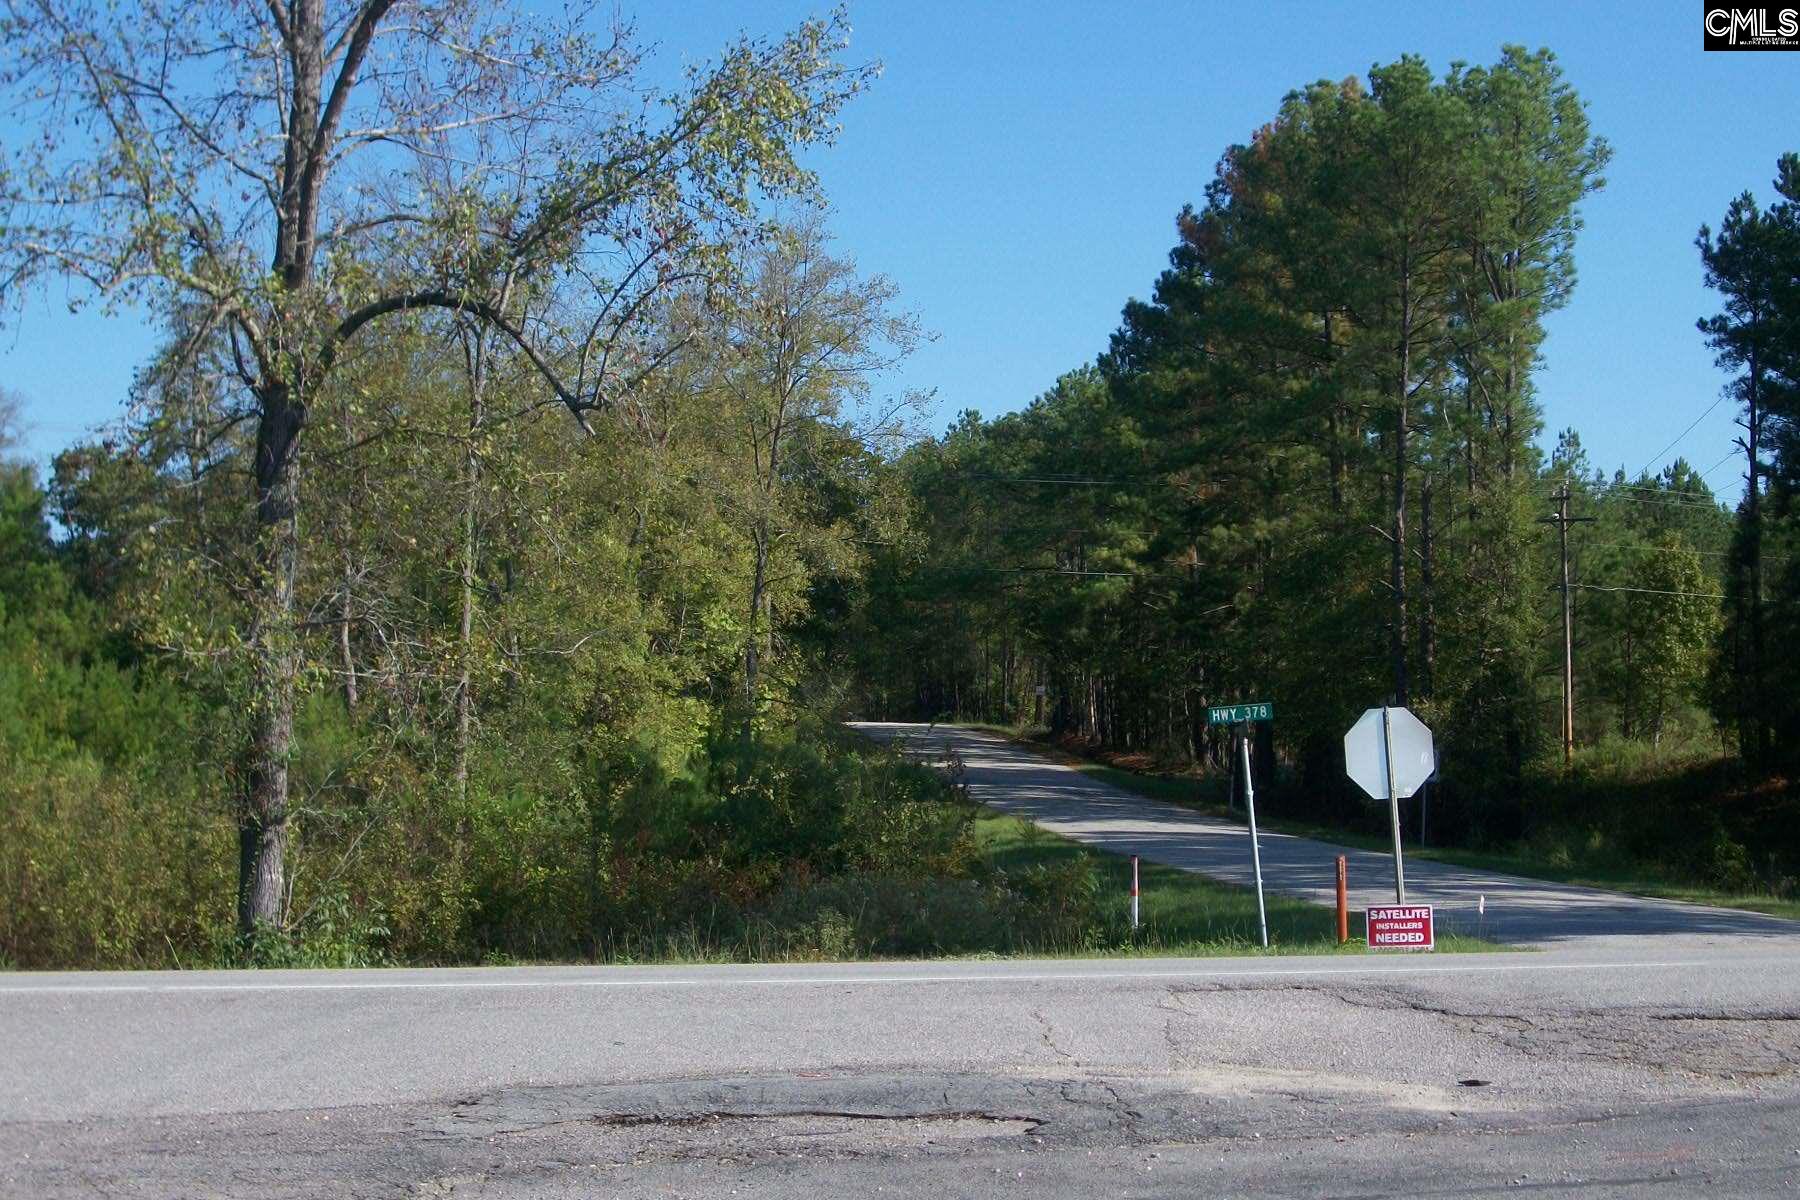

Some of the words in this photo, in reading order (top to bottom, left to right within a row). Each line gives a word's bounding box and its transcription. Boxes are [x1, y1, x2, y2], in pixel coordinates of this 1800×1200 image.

[1212, 708, 1237, 721] HWY
[1244, 706, 1267, 719] 378
[1370, 909, 1429, 920] SATELLITE
[1376, 922, 1423, 930] INSTALLERS
[1375, 932, 1424, 943] NEEDED
